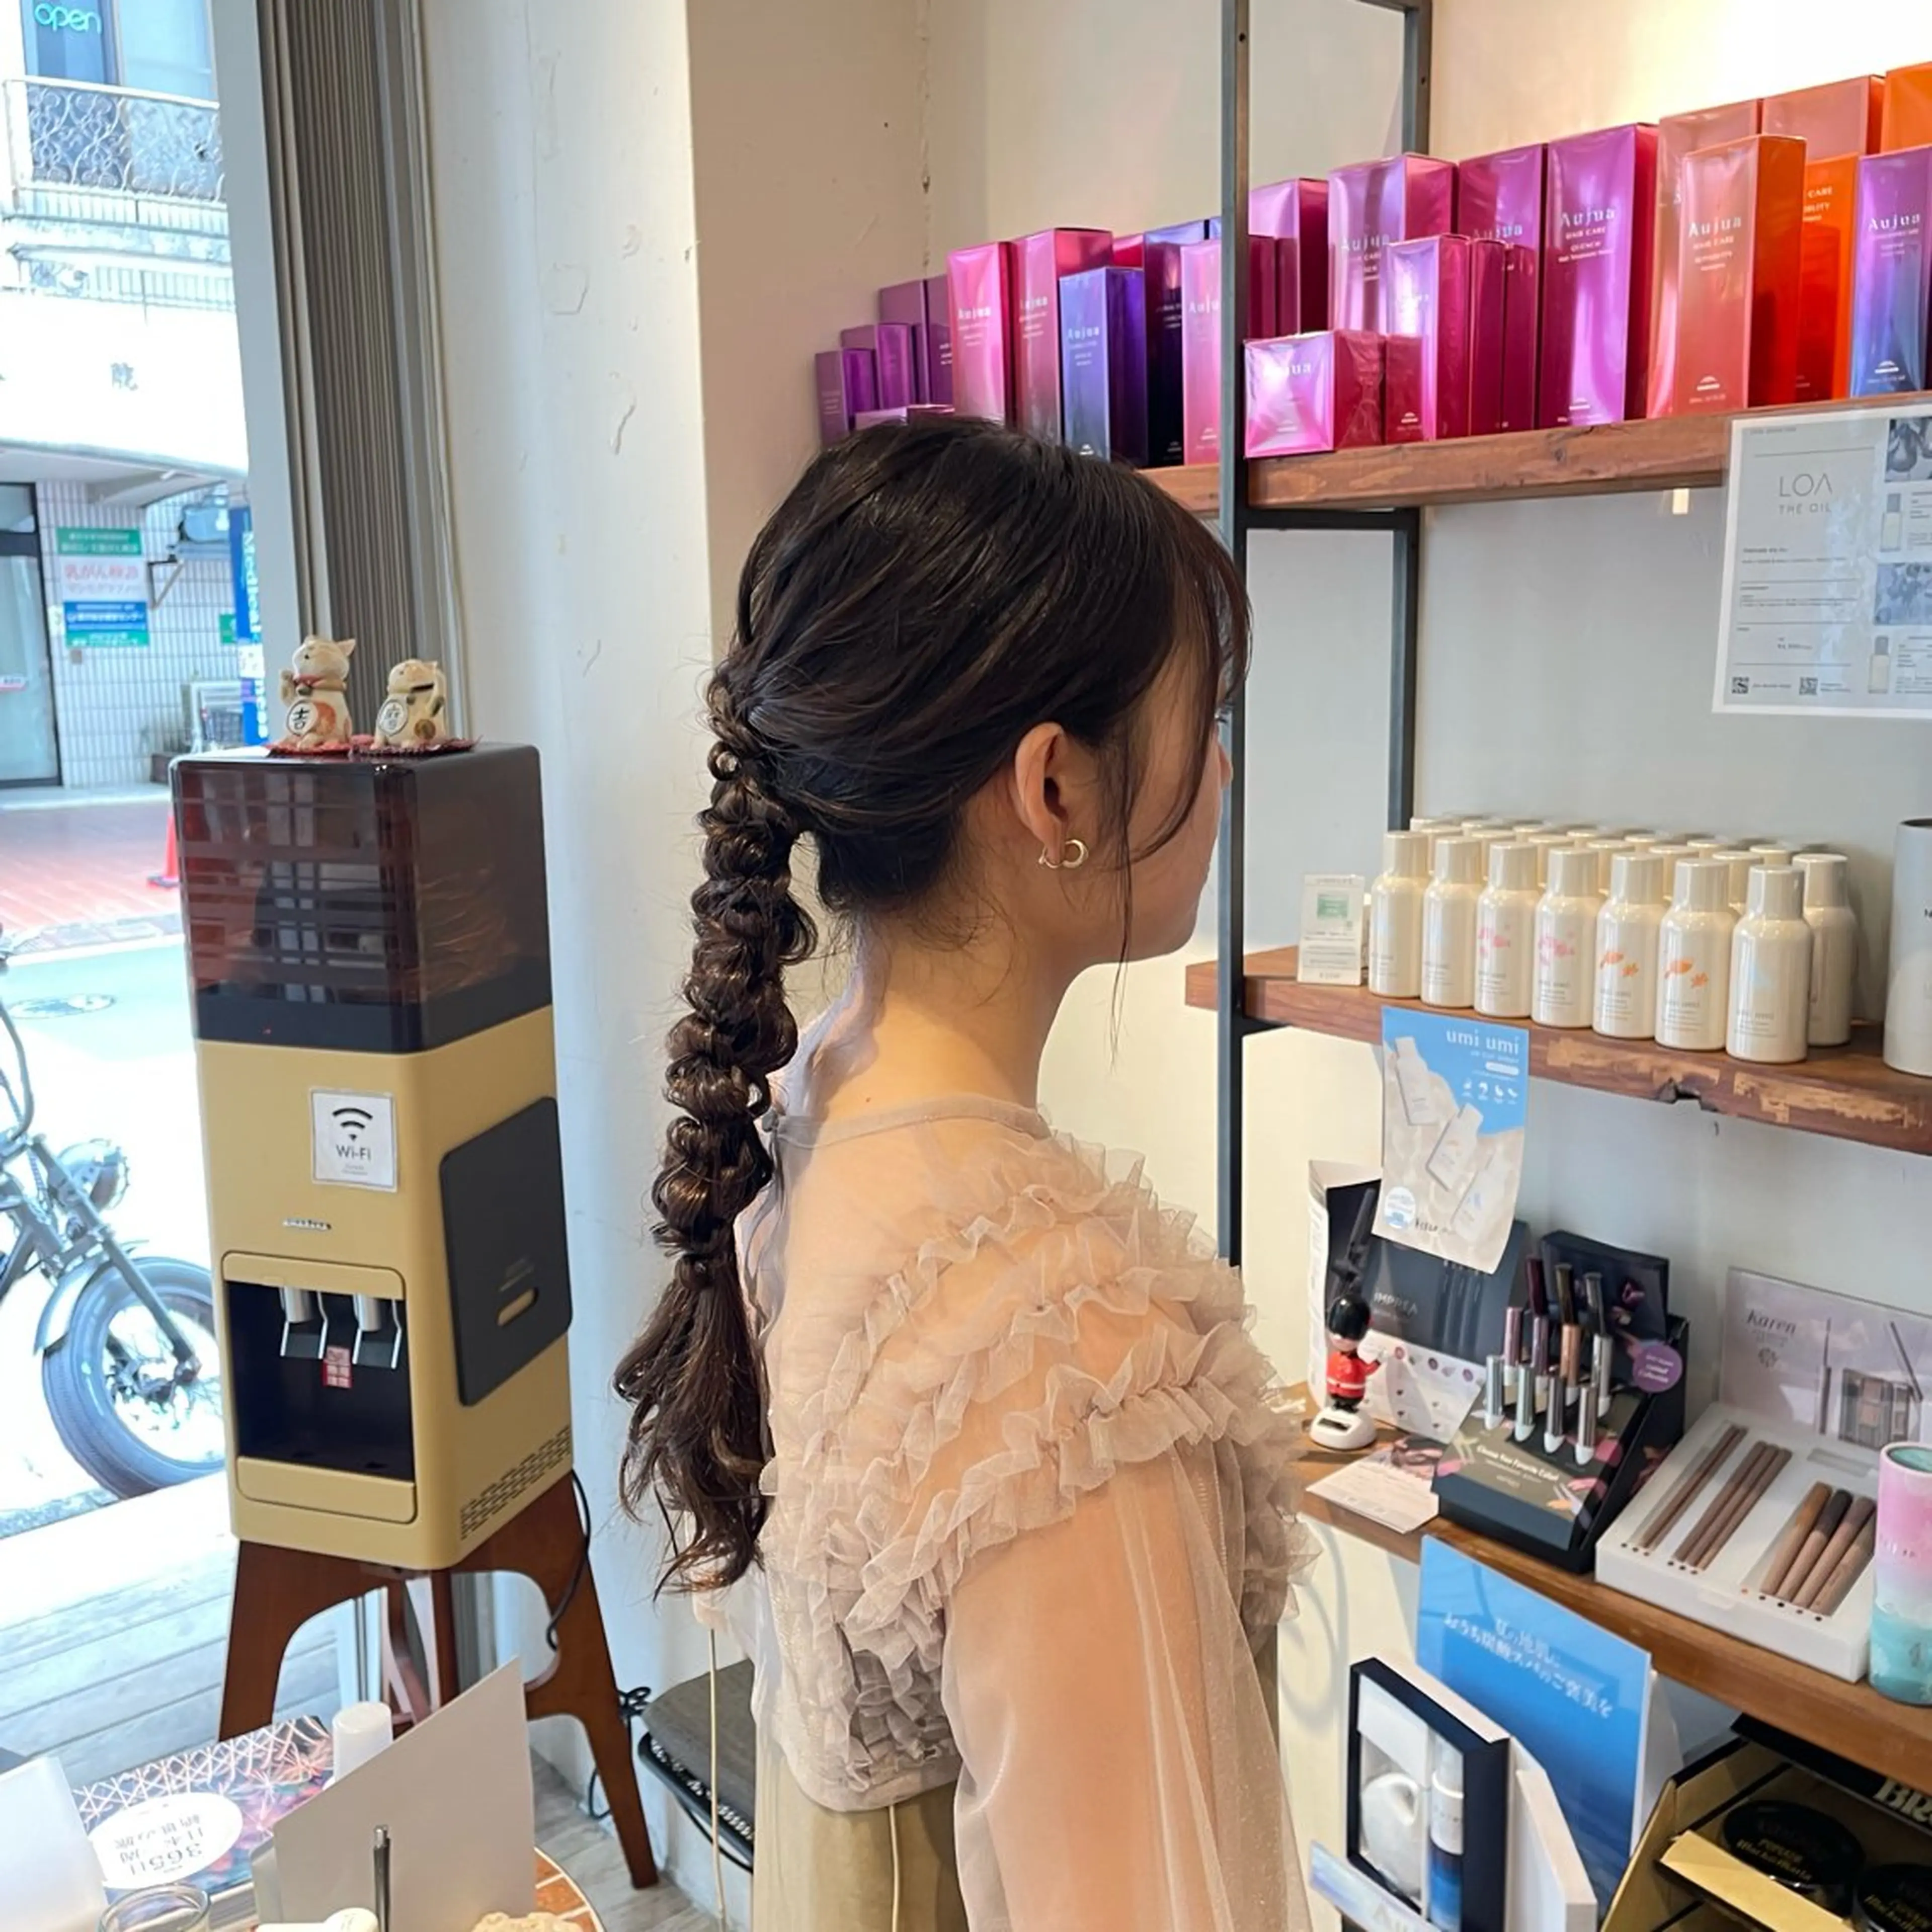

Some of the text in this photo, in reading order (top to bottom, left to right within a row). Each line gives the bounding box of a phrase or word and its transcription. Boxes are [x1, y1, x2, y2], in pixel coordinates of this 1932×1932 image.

[35, 3, 101, 34] open
[1562, 208, 1615, 227] Aujua
[1689, 217, 1741, 237] Aujua
[1868, 213, 1920, 232] Aujua
[1585, 226, 1605, 236] CARE
[1188, 296, 1220, 313] Auju
[1068, 327, 1099, 341] Aujua
[1779, 472, 1833, 497] LOA
[1779, 503, 1832, 515] THE OIL
[1446, 1028, 1519, 1055] umi umi
[336, 1144, 372, 1161] Wi-Fi
[1873, 1777, 1932, 1823] BR
